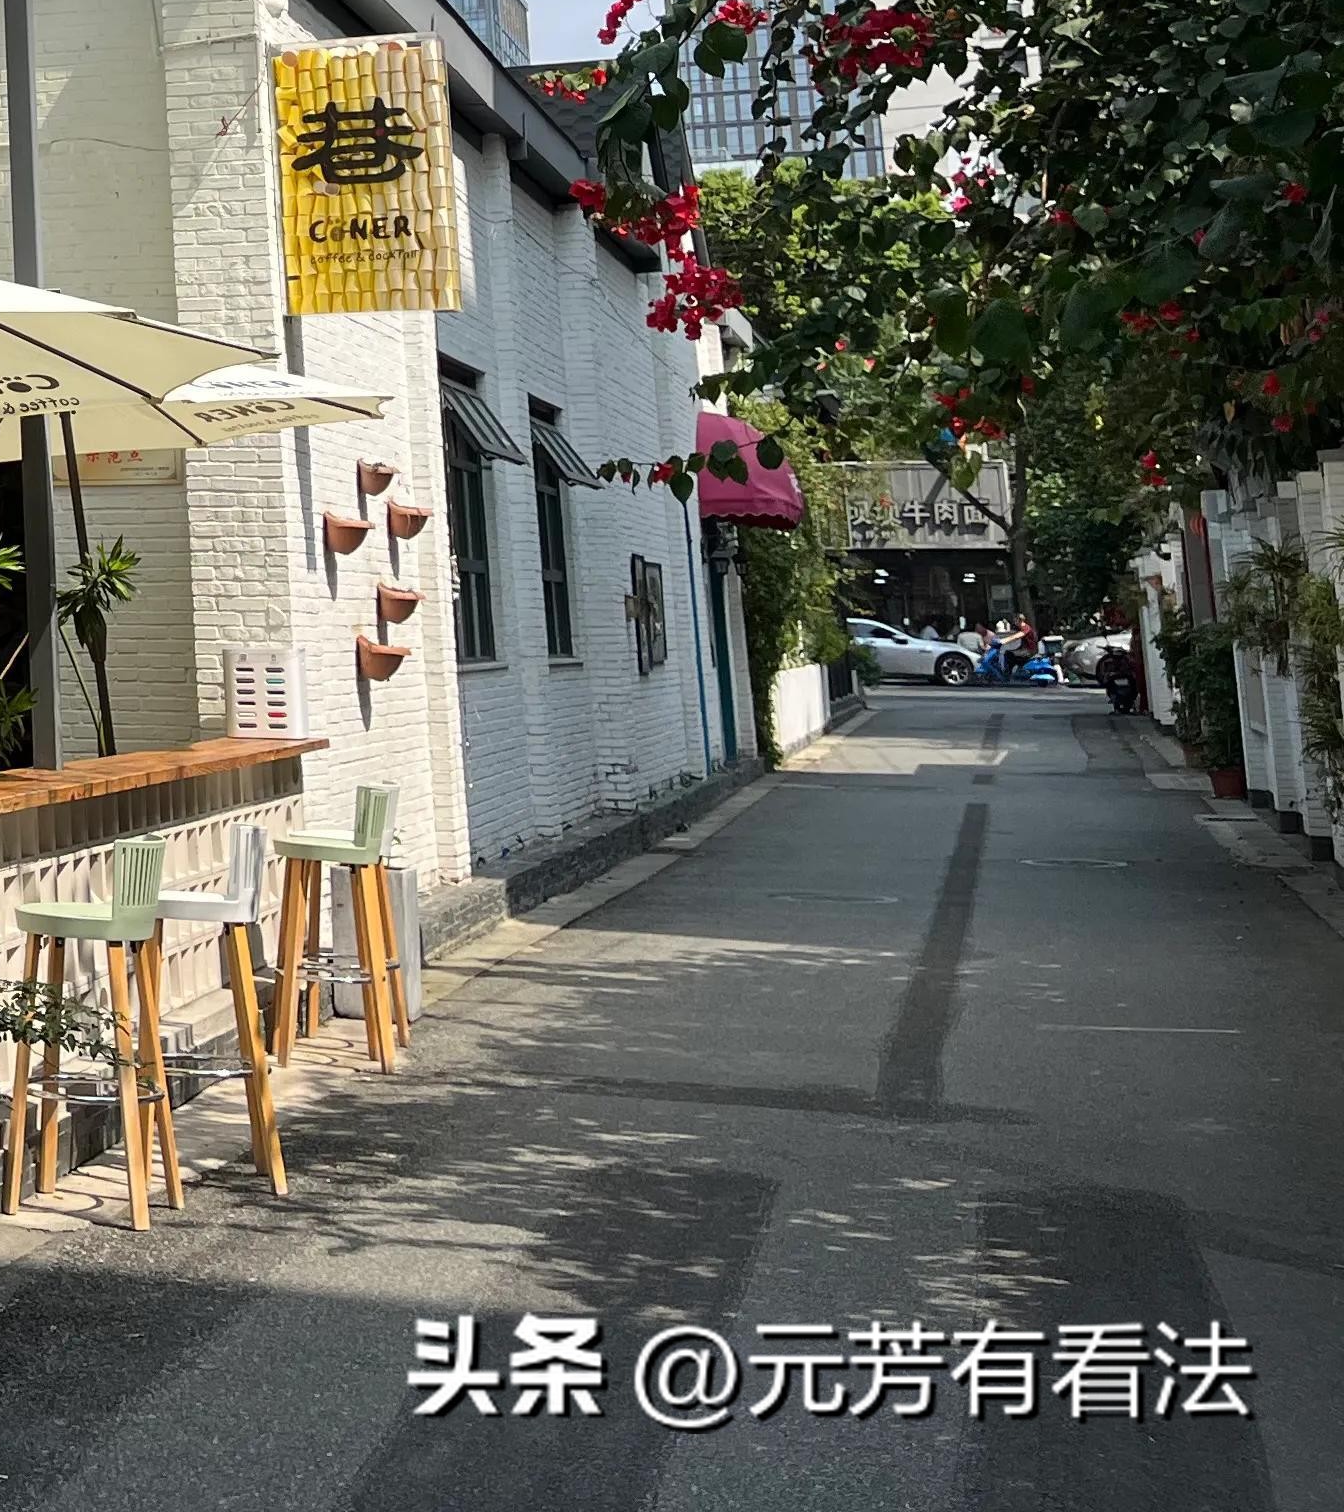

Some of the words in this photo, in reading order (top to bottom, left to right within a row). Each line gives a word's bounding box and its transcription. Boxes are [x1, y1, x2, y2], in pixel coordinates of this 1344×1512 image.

[291, 96, 424, 184] 巷
[311, 252, 352, 265] coffee
[356, 251, 365, 262] &
